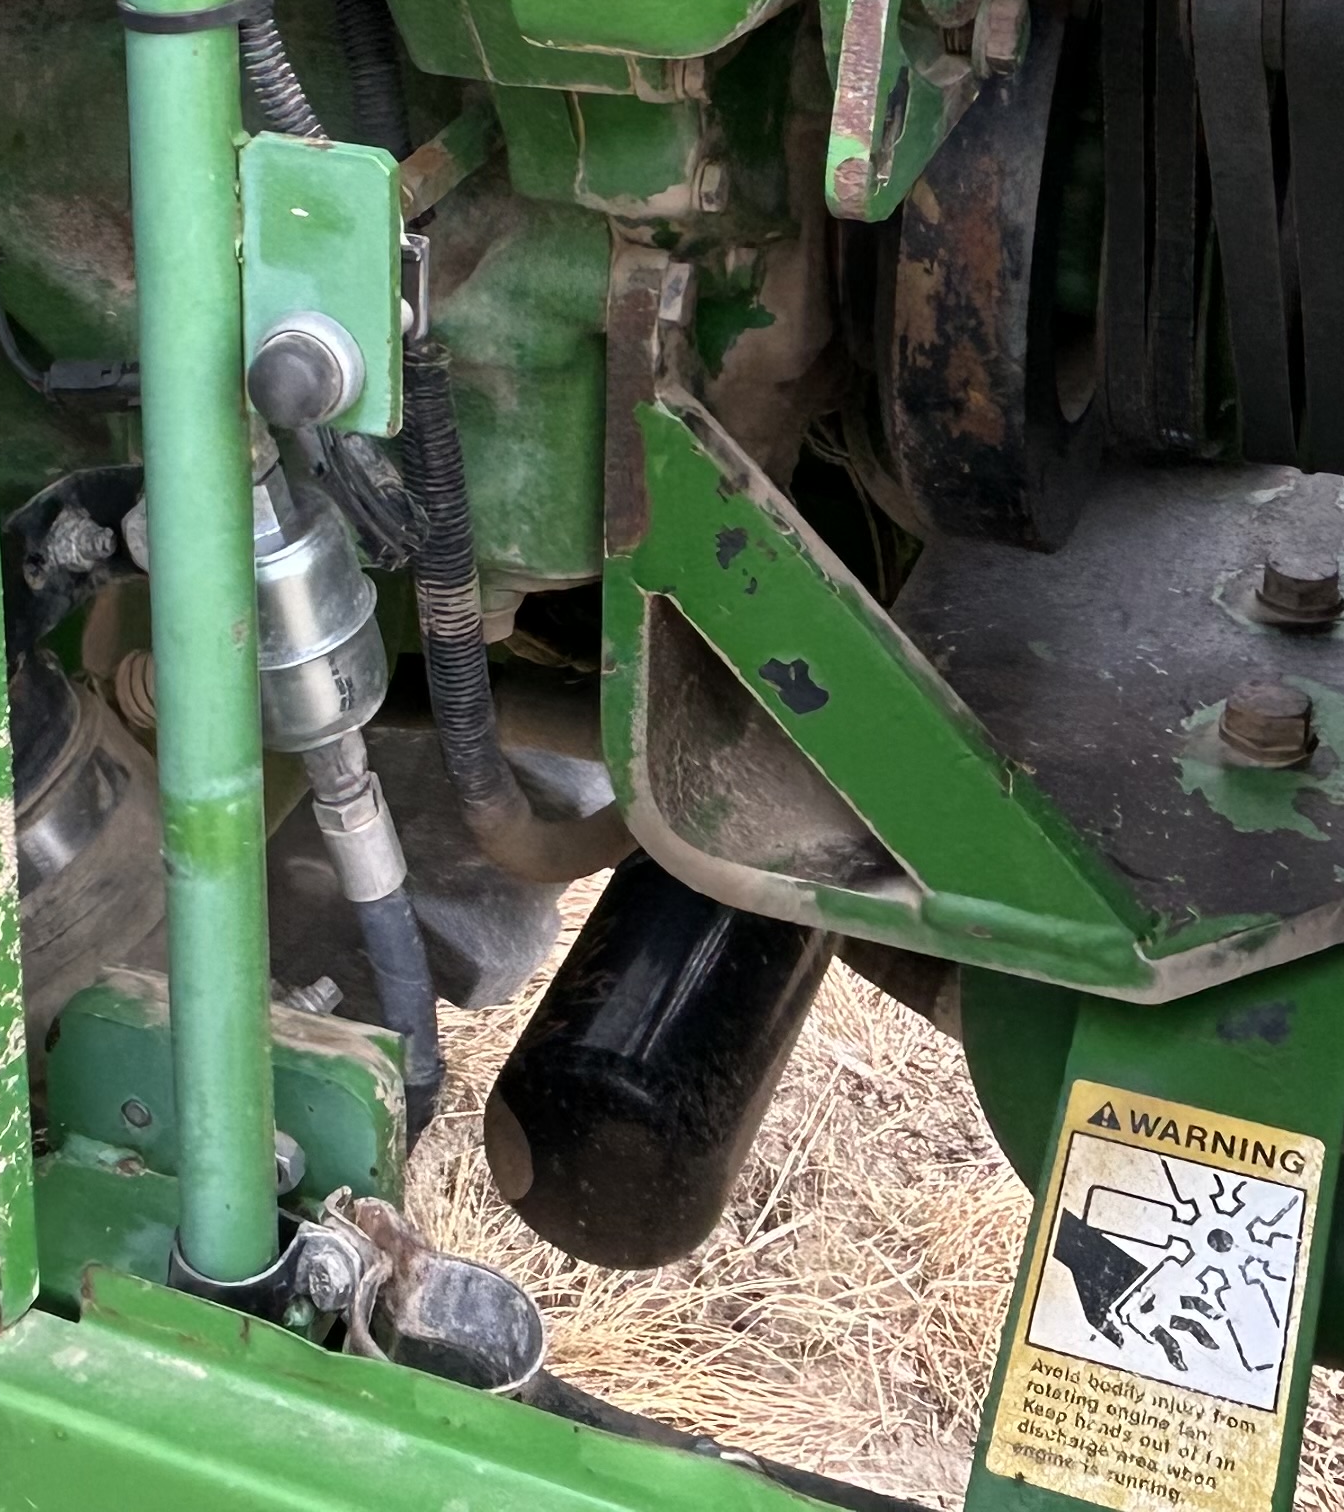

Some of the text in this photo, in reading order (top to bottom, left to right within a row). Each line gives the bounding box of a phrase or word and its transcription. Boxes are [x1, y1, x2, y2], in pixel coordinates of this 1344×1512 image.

[1129, 1108, 1307, 1177] WARNING
[1026, 1379, 1100, 1414] rotating
[1105, 1403, 1171, 1431] engine
[1030, 1357, 1257, 1434] Avoid bodily injury from
[1011, 1442, 1074, 1469] engine
[1081, 1458, 1100, 1477] is
[1016, 1417, 1218, 1489] discharge area when
[1022, 1395, 1236, 1472] Keep hands out of fan
